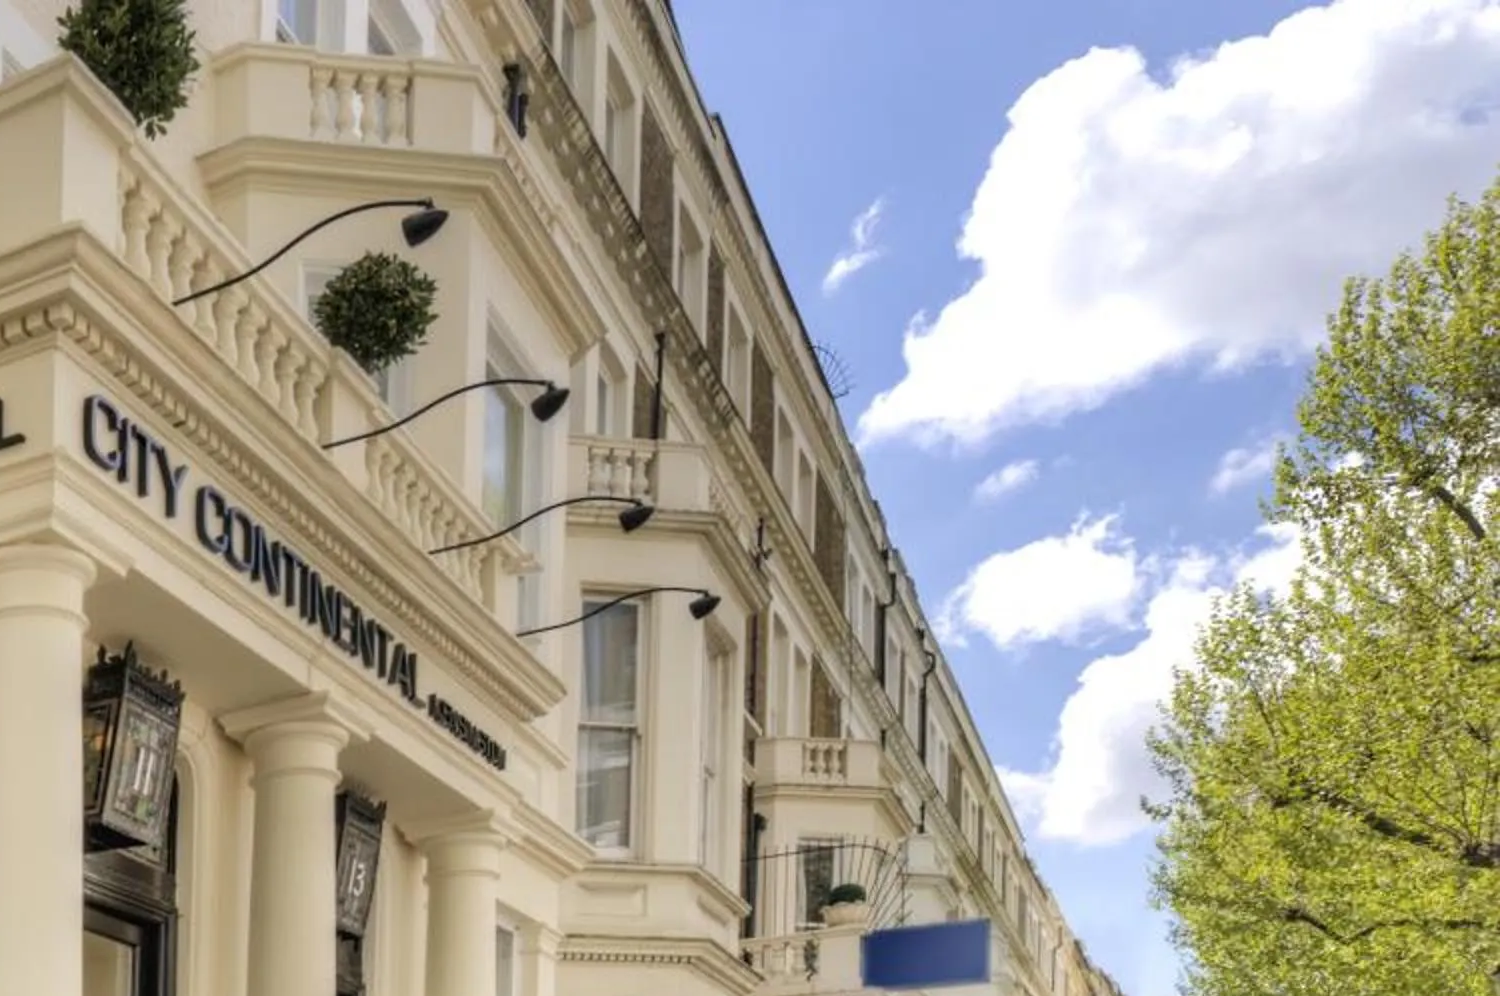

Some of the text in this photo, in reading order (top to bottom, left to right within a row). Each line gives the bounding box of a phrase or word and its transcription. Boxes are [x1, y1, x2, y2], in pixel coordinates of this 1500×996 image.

[83, 395, 188, 518] CITY
[196, 485, 426, 709] CONTINENTAL
[348, 858, 366, 897] 13
